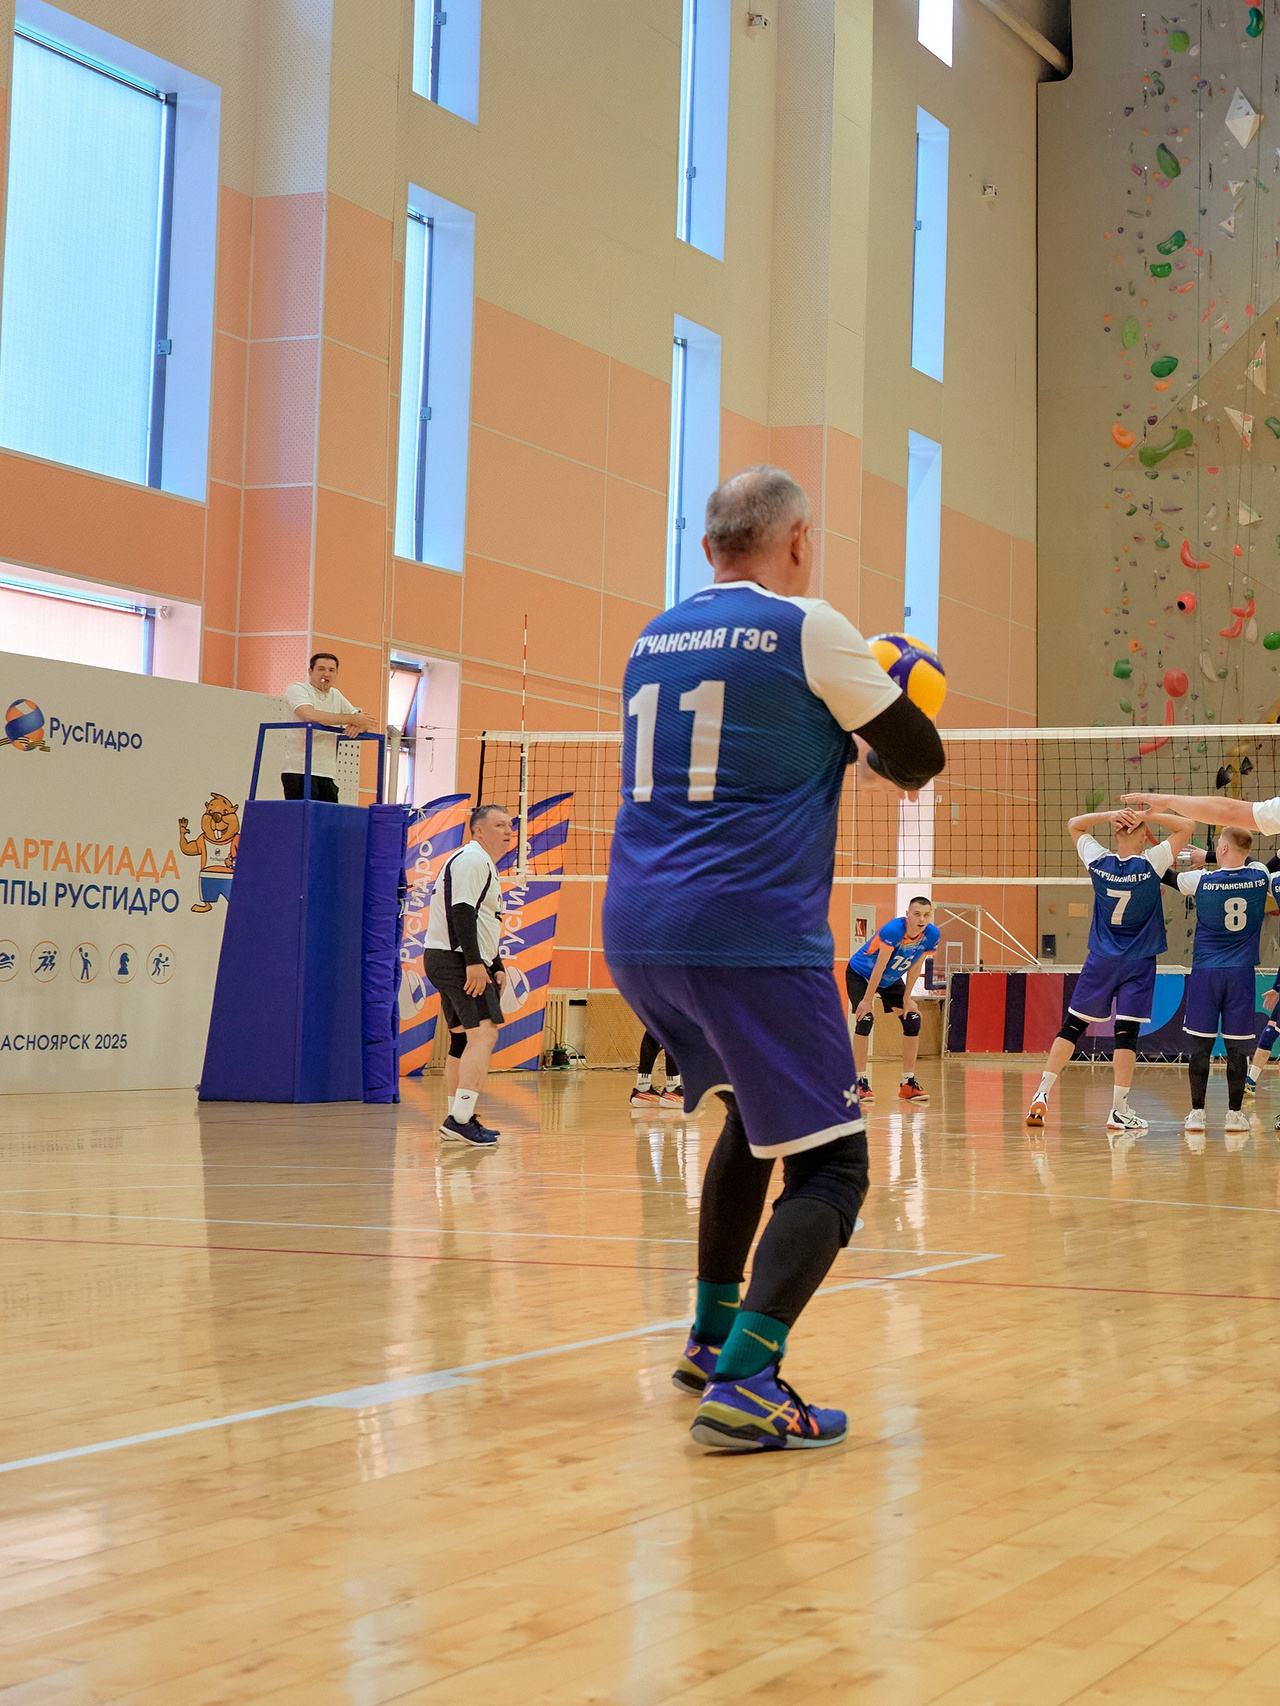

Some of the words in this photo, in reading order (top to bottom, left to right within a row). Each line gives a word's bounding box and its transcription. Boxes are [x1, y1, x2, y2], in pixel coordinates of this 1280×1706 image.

[730, 627, 778, 653] ГЭС
[50, 717, 143, 751] РусГидро
[628, 680, 726, 802] 11
[0, 837, 181, 883] АРТАКИАДА
[54, 882, 180, 916] РУСГИДРО
[1203, 881, 1254, 891] БОГУЧАНСКАЯ
[1254, 879, 1266, 888] ГЭС
[1106, 888, 1132, 925] 7
[1224, 897, 1248, 932] 8
[1, 1034, 91, 1050] АСНОЯРСК
[94, 1034, 128, 1049] 2025
